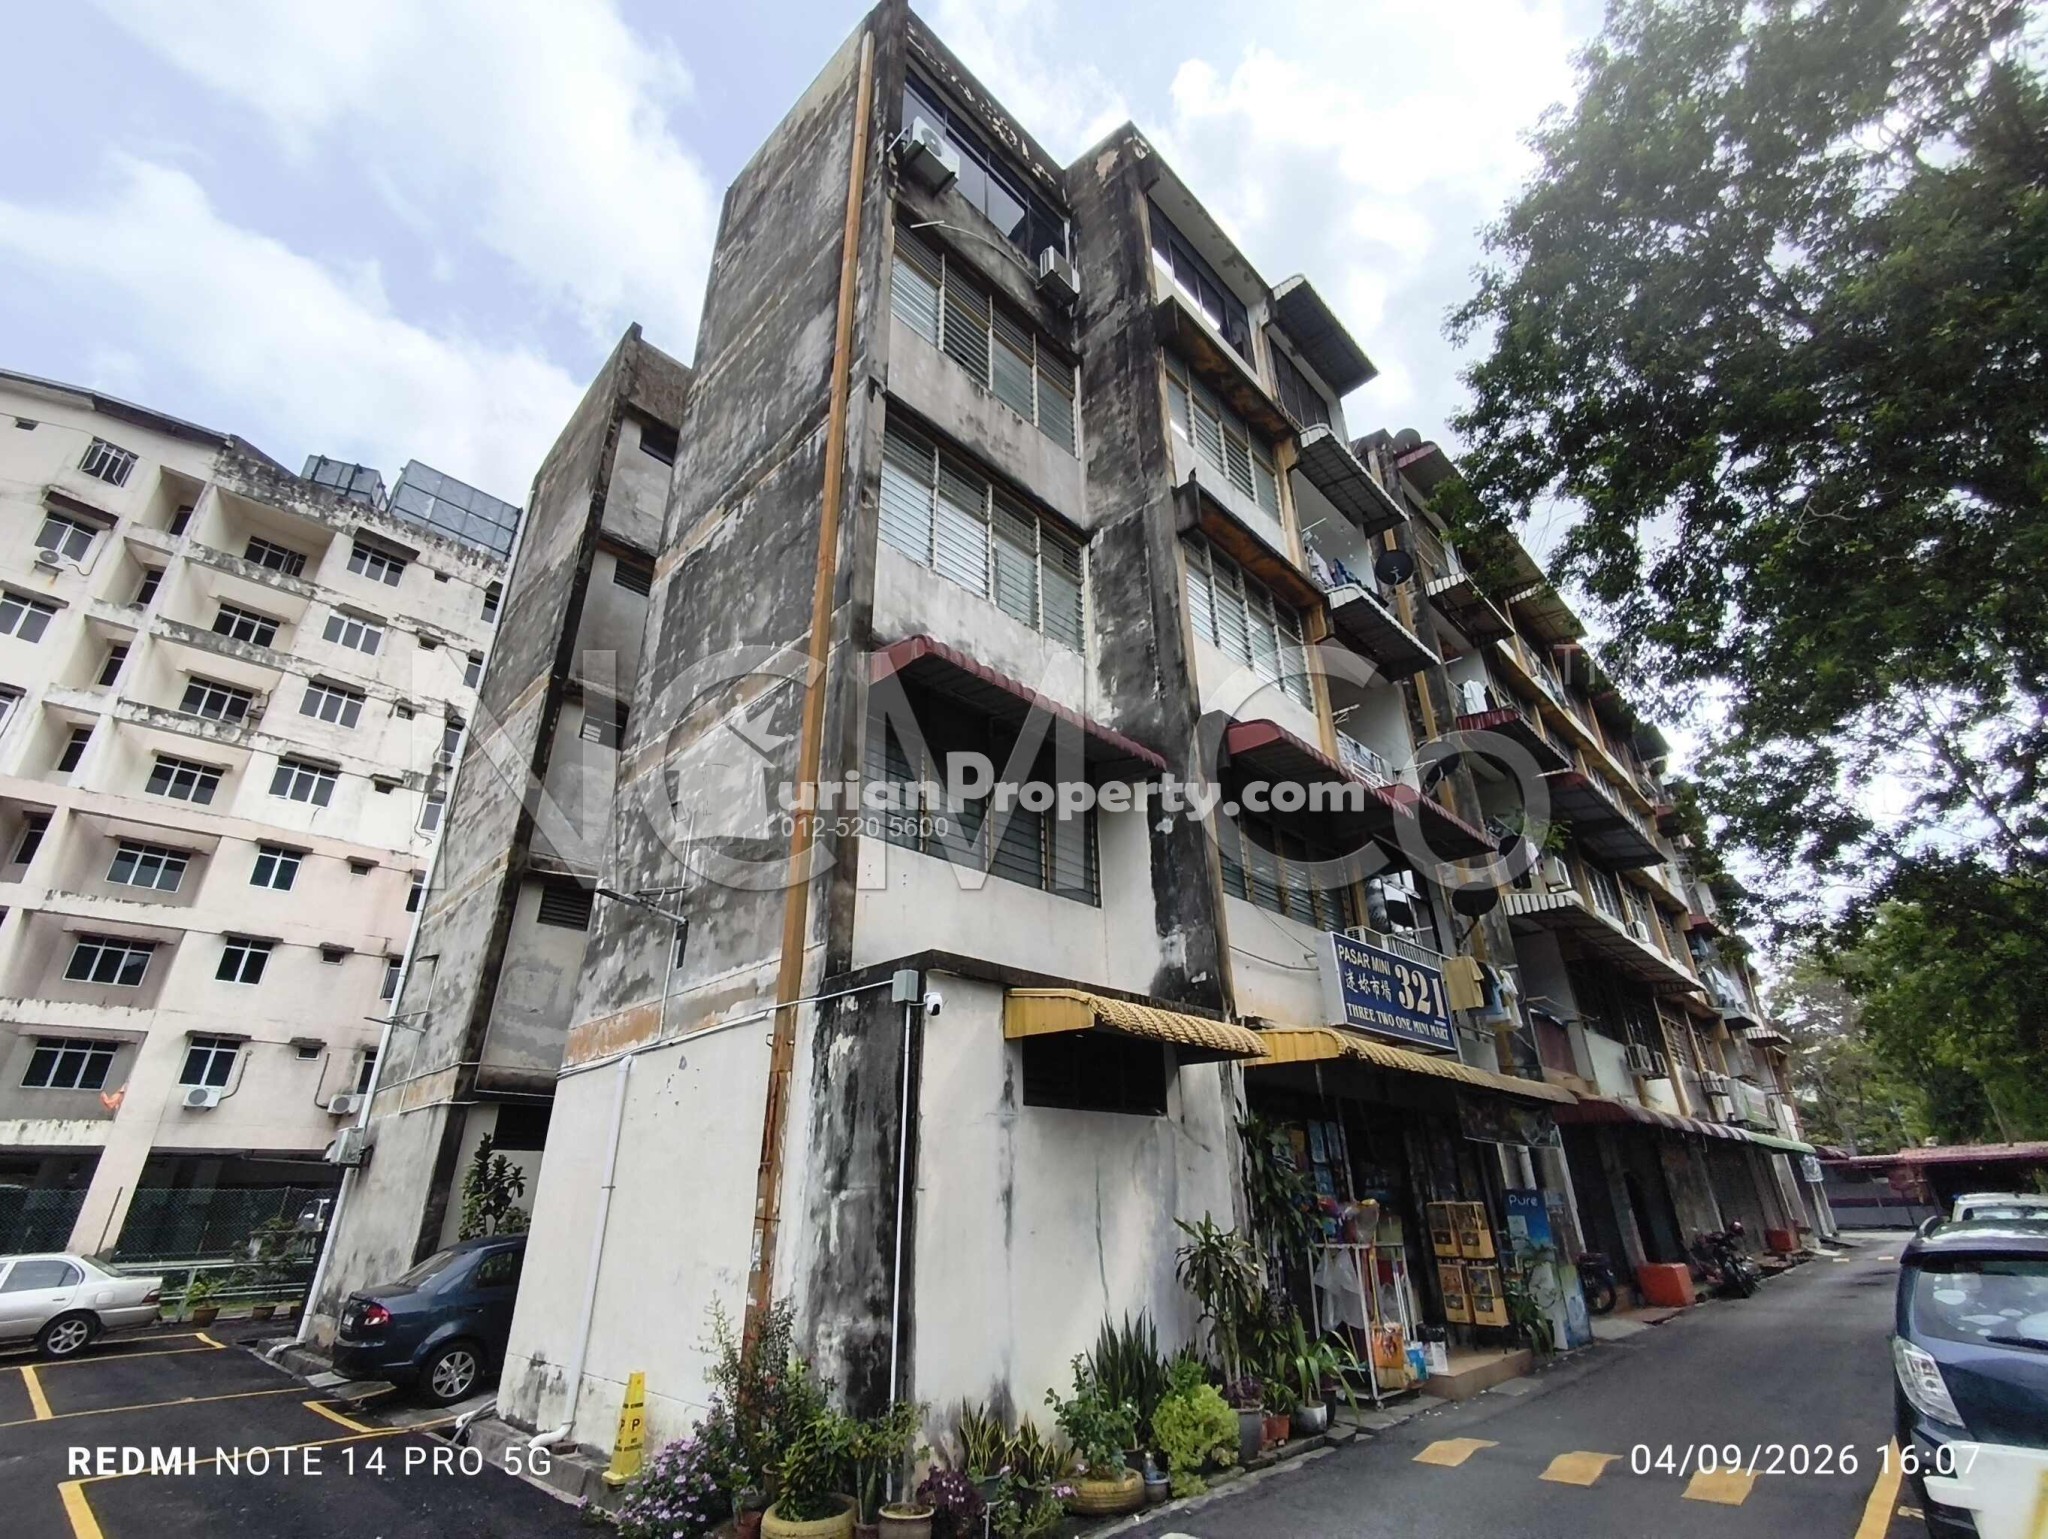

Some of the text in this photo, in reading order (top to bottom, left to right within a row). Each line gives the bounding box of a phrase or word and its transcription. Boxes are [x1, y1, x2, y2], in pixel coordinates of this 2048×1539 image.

[1338, 944, 1391, 976] PASAR MINI
[1394, 964, 1447, 1020] 321
[1346, 1002, 1449, 1041] THREE TWO ONE MINI MART
[1508, 1194, 1539, 1207] Pure
